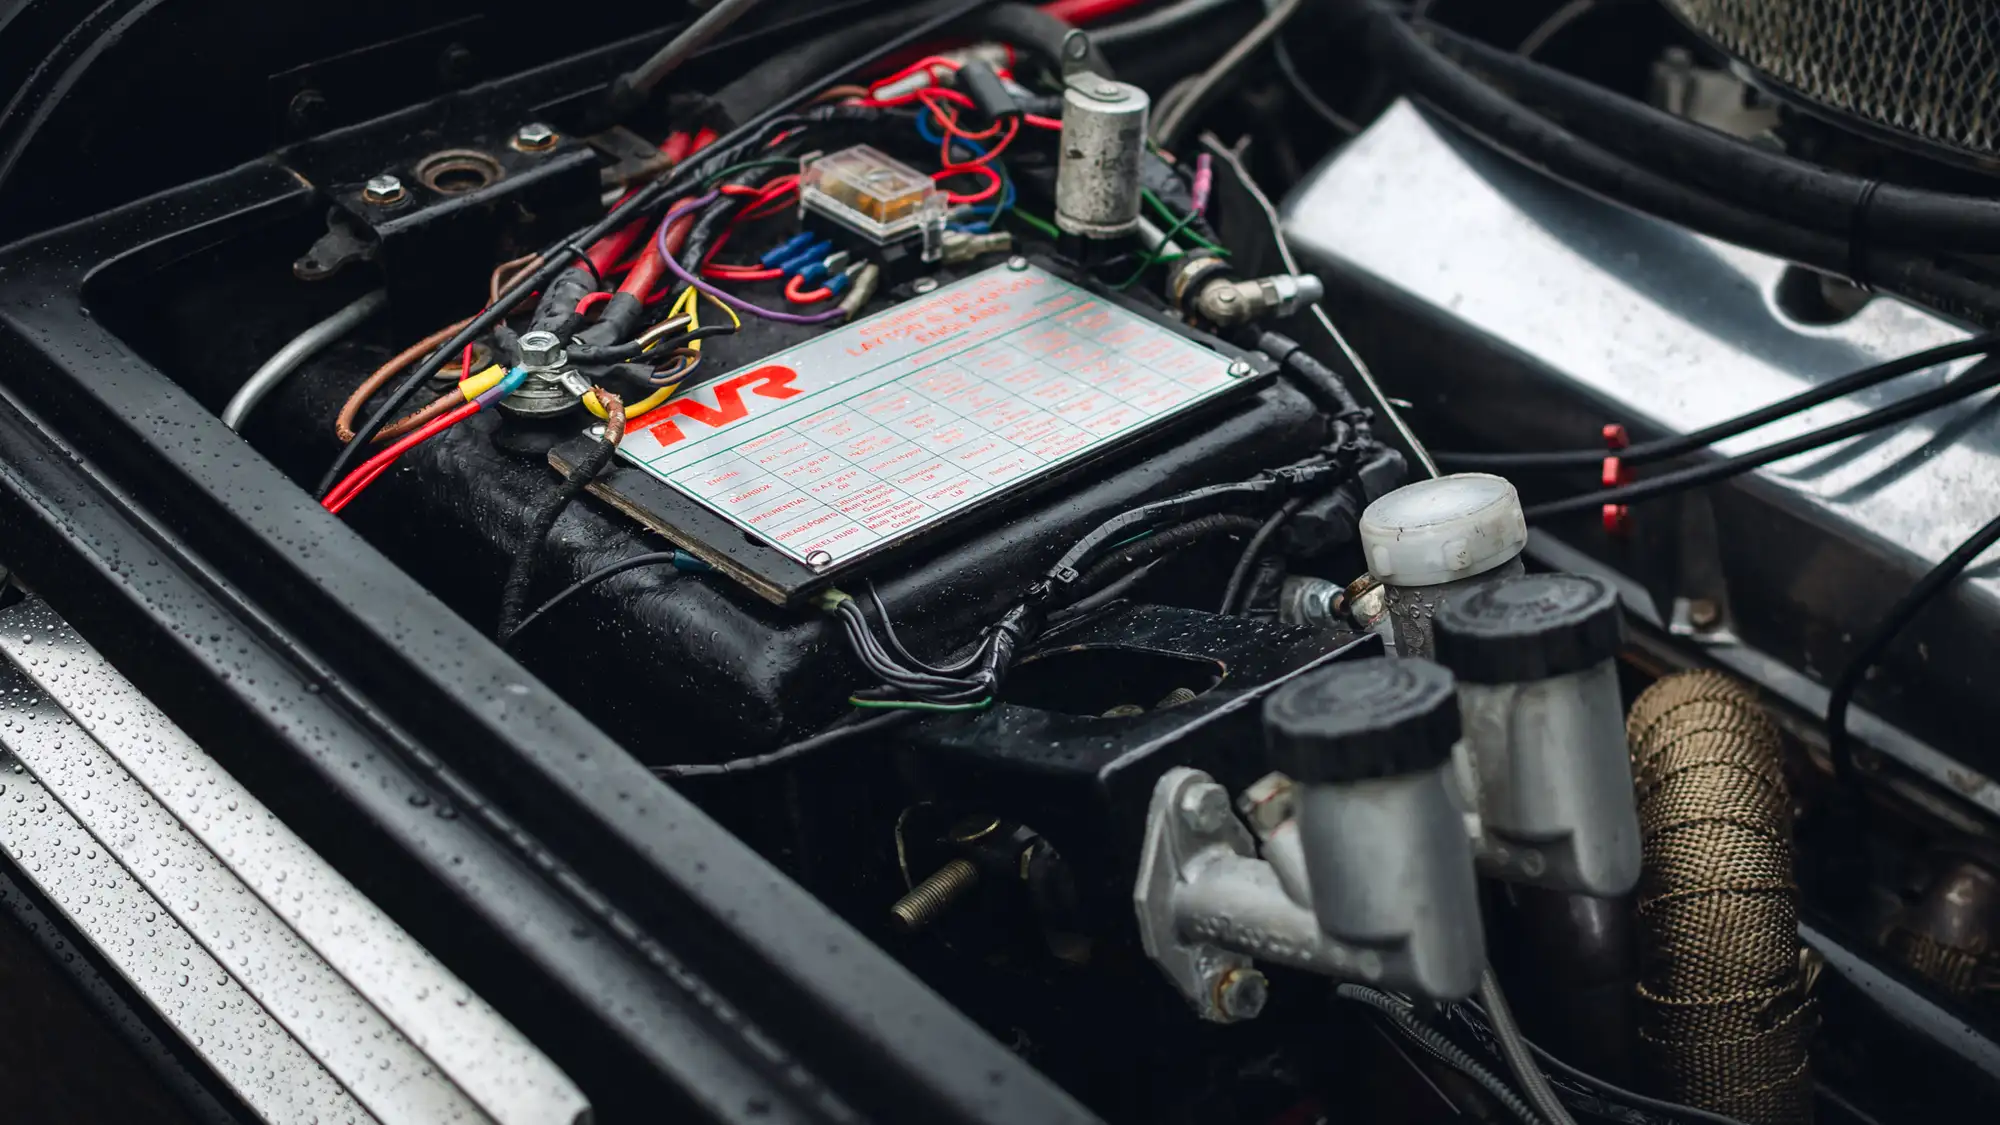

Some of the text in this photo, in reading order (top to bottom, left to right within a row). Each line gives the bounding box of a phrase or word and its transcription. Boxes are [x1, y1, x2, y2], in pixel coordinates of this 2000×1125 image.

[910, 300, 1015, 346] ENGLAND
[841, 320, 928, 358] LAYTON
[624, 364, 805, 447] TVR
[895, 447, 925, 461] Hypoy
[704, 469, 741, 486] ENGINE
[806, 465, 824, 475] Oil
[896, 462, 944, 484] Castrolease
[919, 473, 937, 482] LM
[727, 483, 774, 504] GEARBOX
[833, 483, 886, 507] Lithium Base
[834, 481, 852, 490] Oil
[924, 478, 972, 500] Castrolease
[948, 488, 966, 498] LM
[747, 496, 810, 524] DIFFERENTIAL
[840, 487, 897, 513] Multi Purpose
[861, 497, 893, 512] Grease
[862, 499, 915, 523] Lithium Base
[868, 503, 927, 529] Multi Purpose
[889, 513, 922, 528] Grease
[801, 527, 860, 553] WHEEL HUBS
